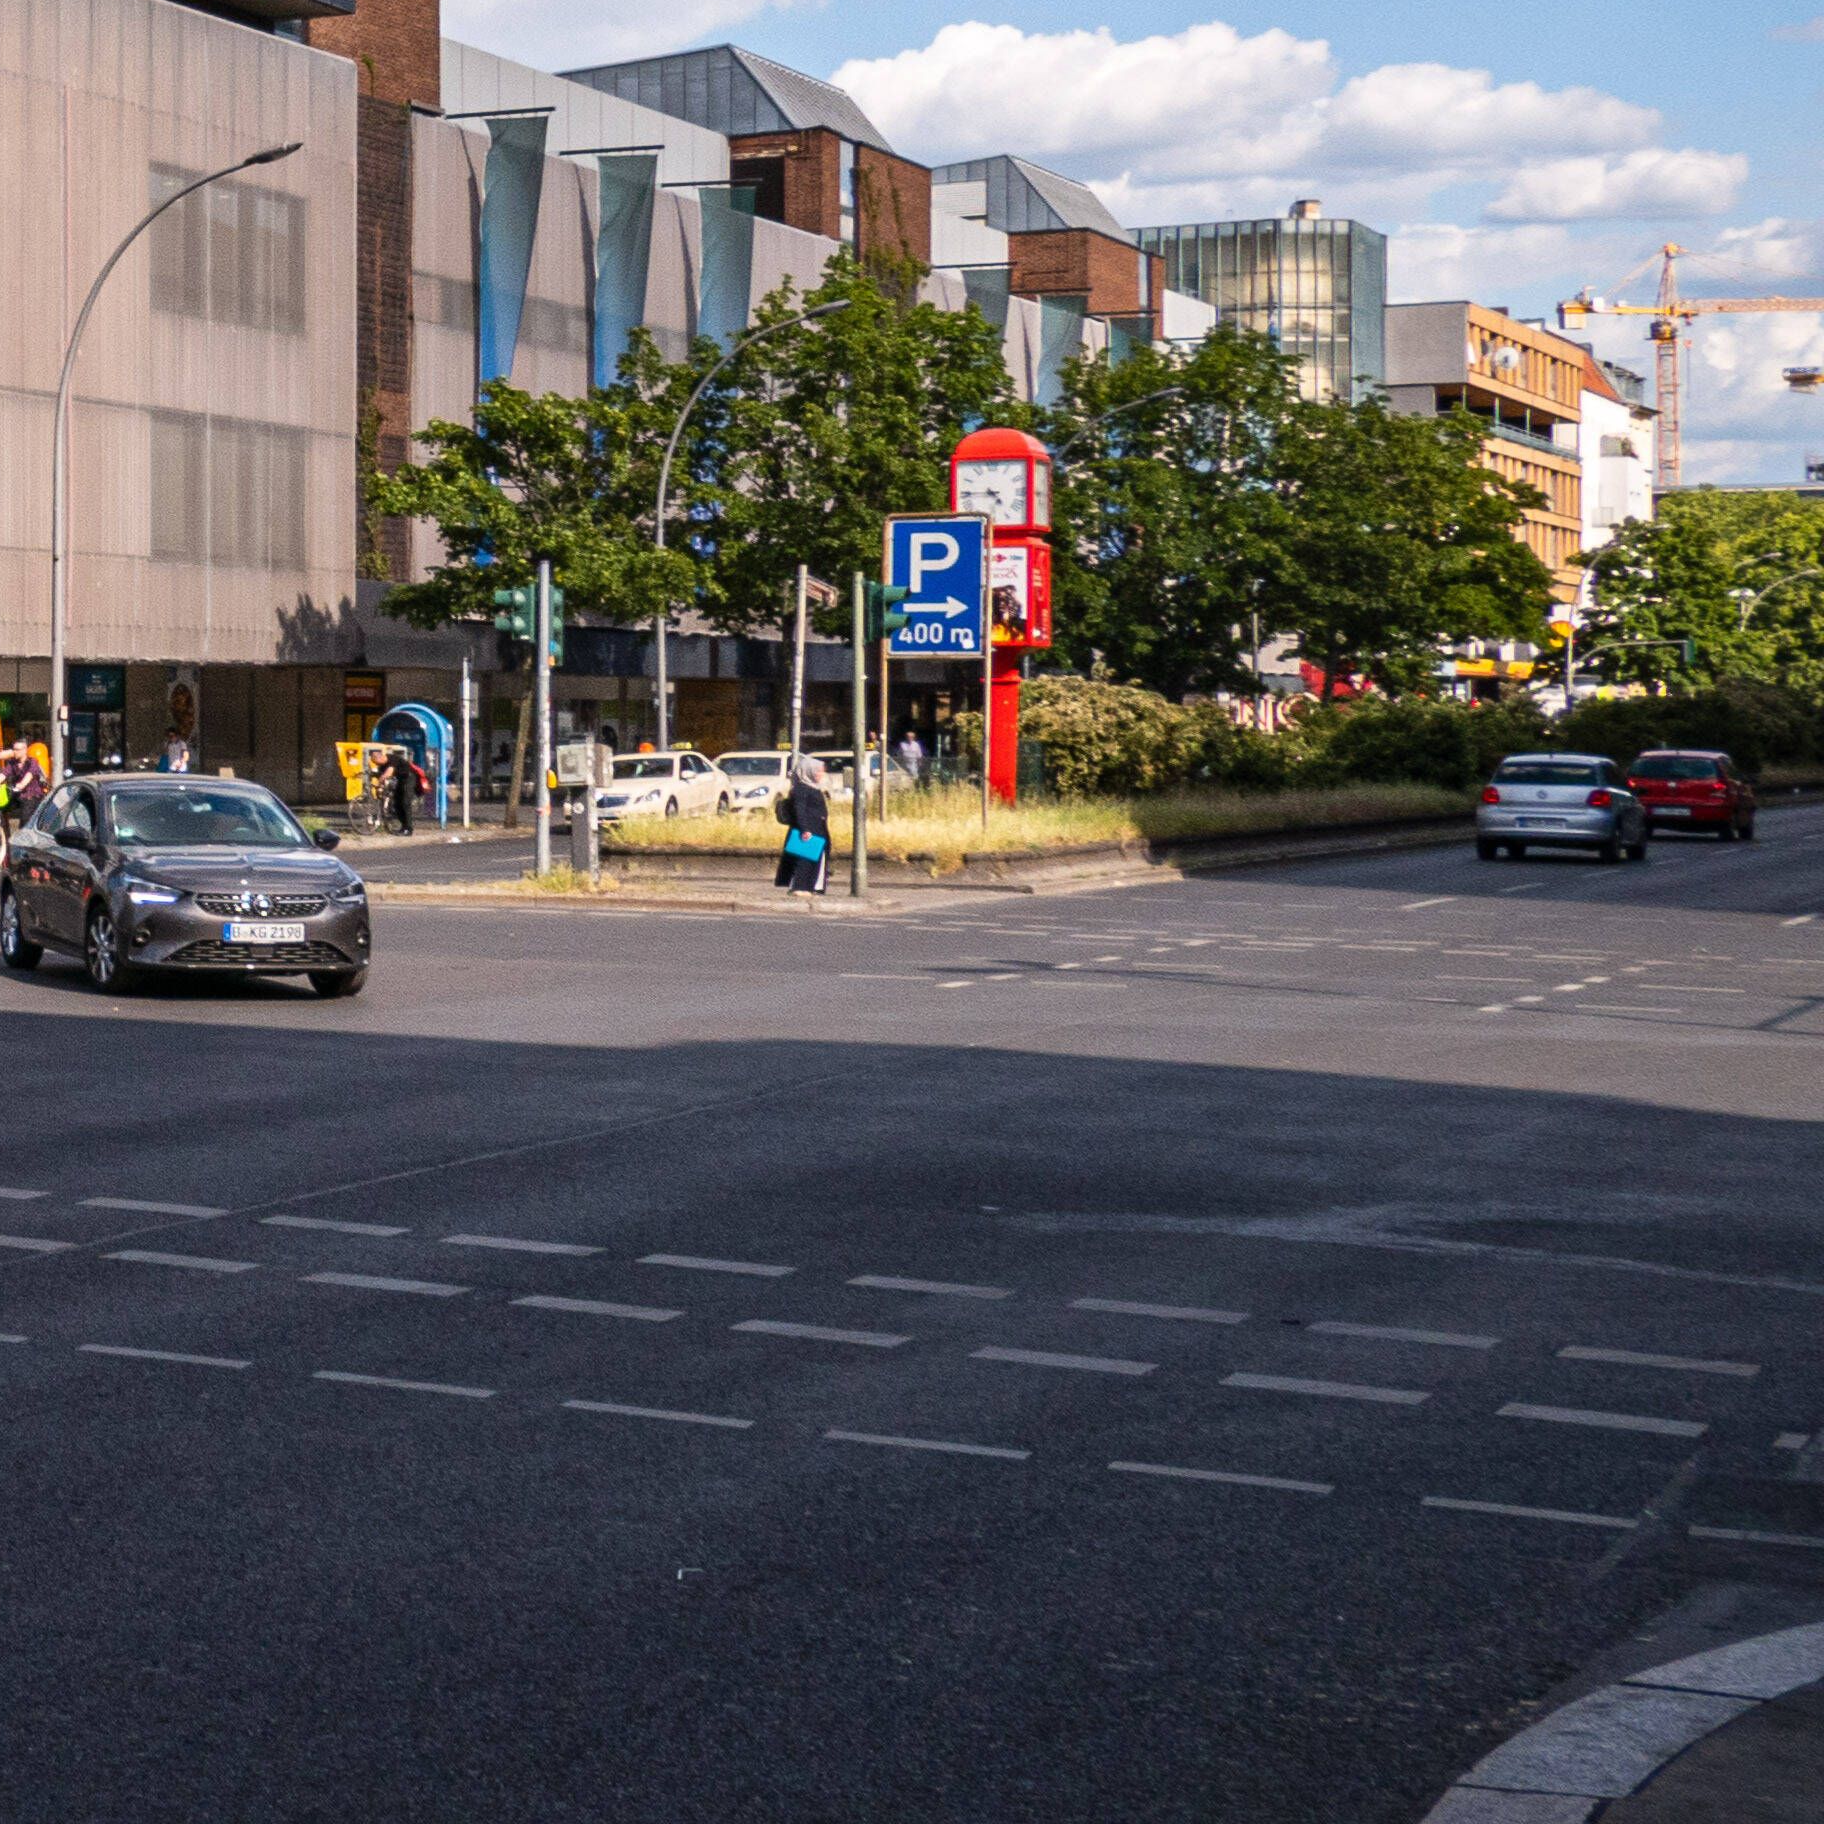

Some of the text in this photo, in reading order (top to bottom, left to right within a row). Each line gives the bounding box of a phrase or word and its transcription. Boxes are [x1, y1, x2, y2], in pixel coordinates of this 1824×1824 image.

[910, 532, 960, 593] P
[899, 623, 974, 646] 400 m
